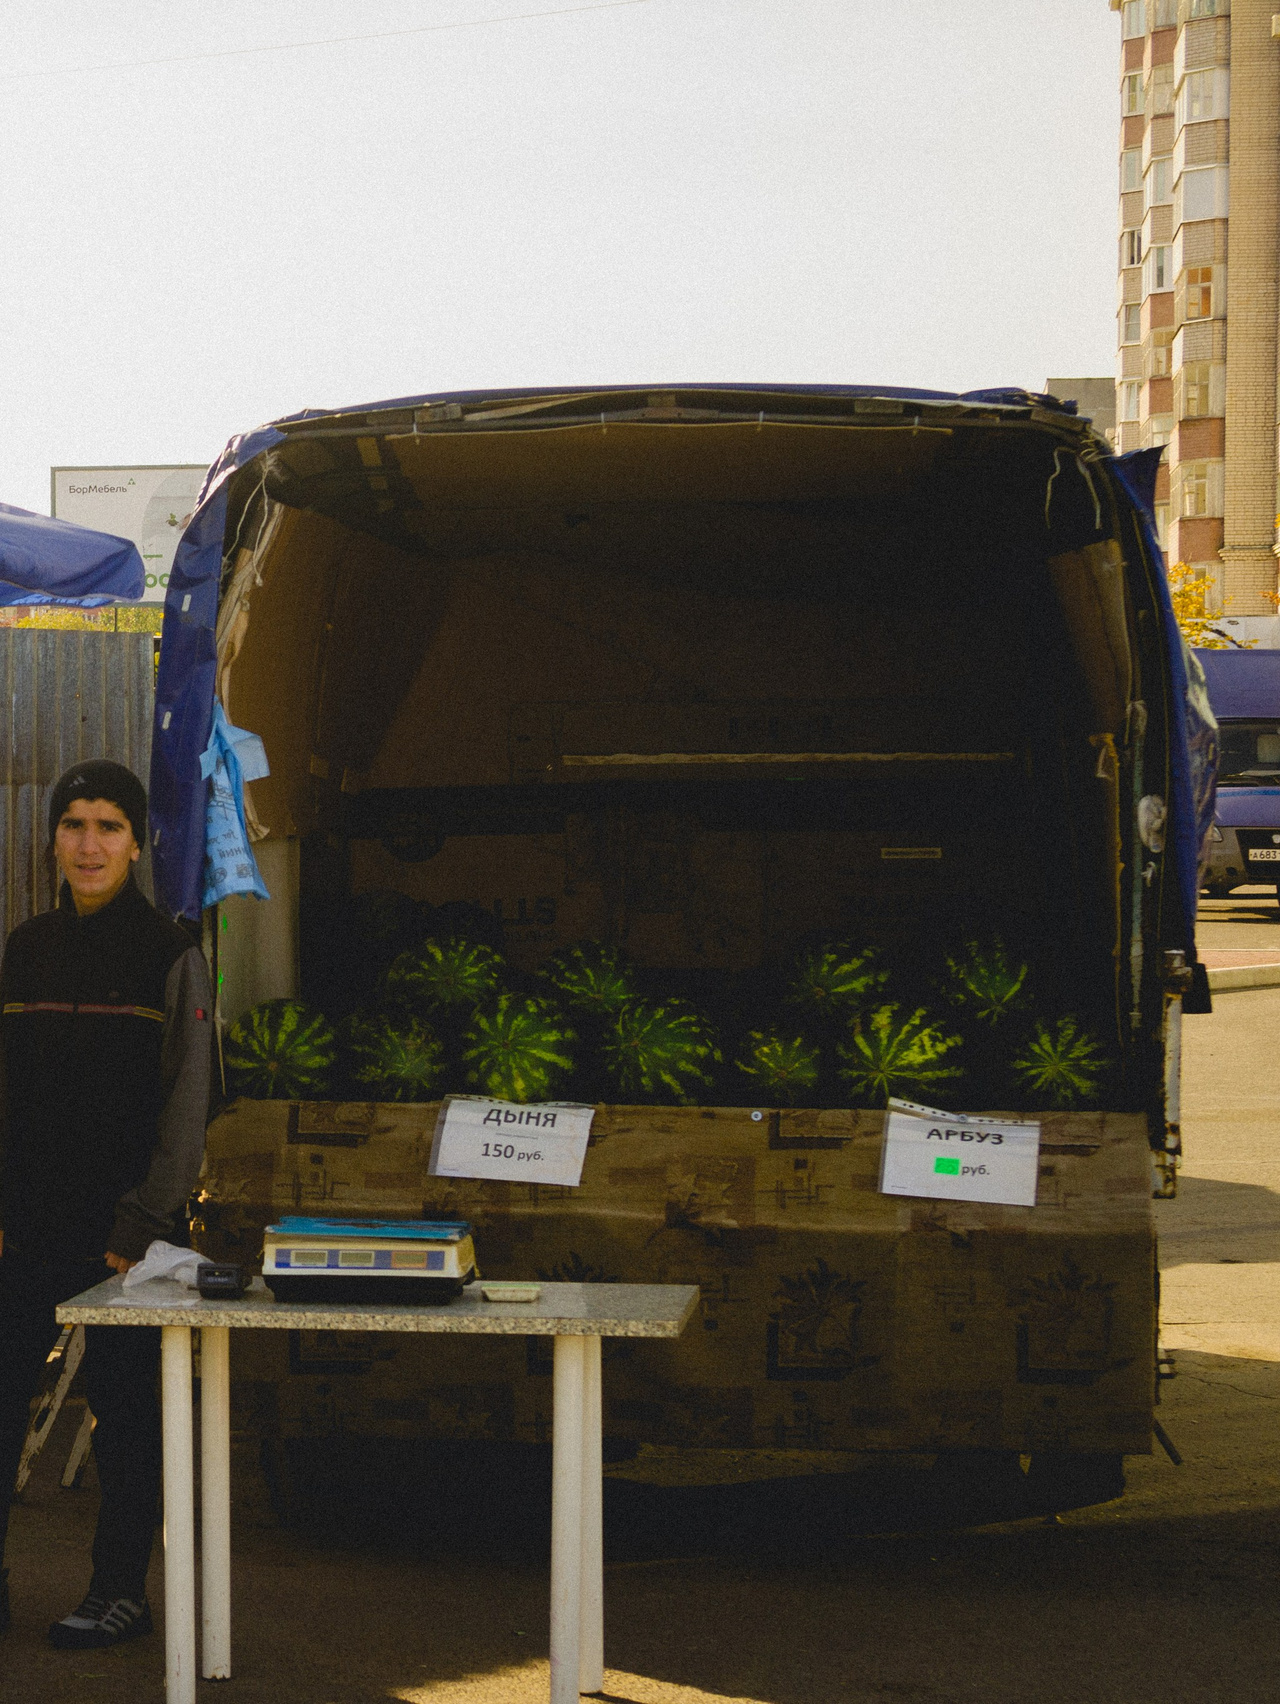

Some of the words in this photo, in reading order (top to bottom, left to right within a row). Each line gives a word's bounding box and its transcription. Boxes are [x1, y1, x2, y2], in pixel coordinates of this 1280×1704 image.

[69, 485, 128, 494] БорМебель
[1252, 850, 1280, 860] А683
[483, 1108, 557, 1128] ДЫНЯ
[926, 1128, 1004, 1145] АРБУЗ
[481, 1142, 515, 1159] 150
[517, 1150, 545, 1162] руб.
[961, 1164, 991, 1176] руб.
